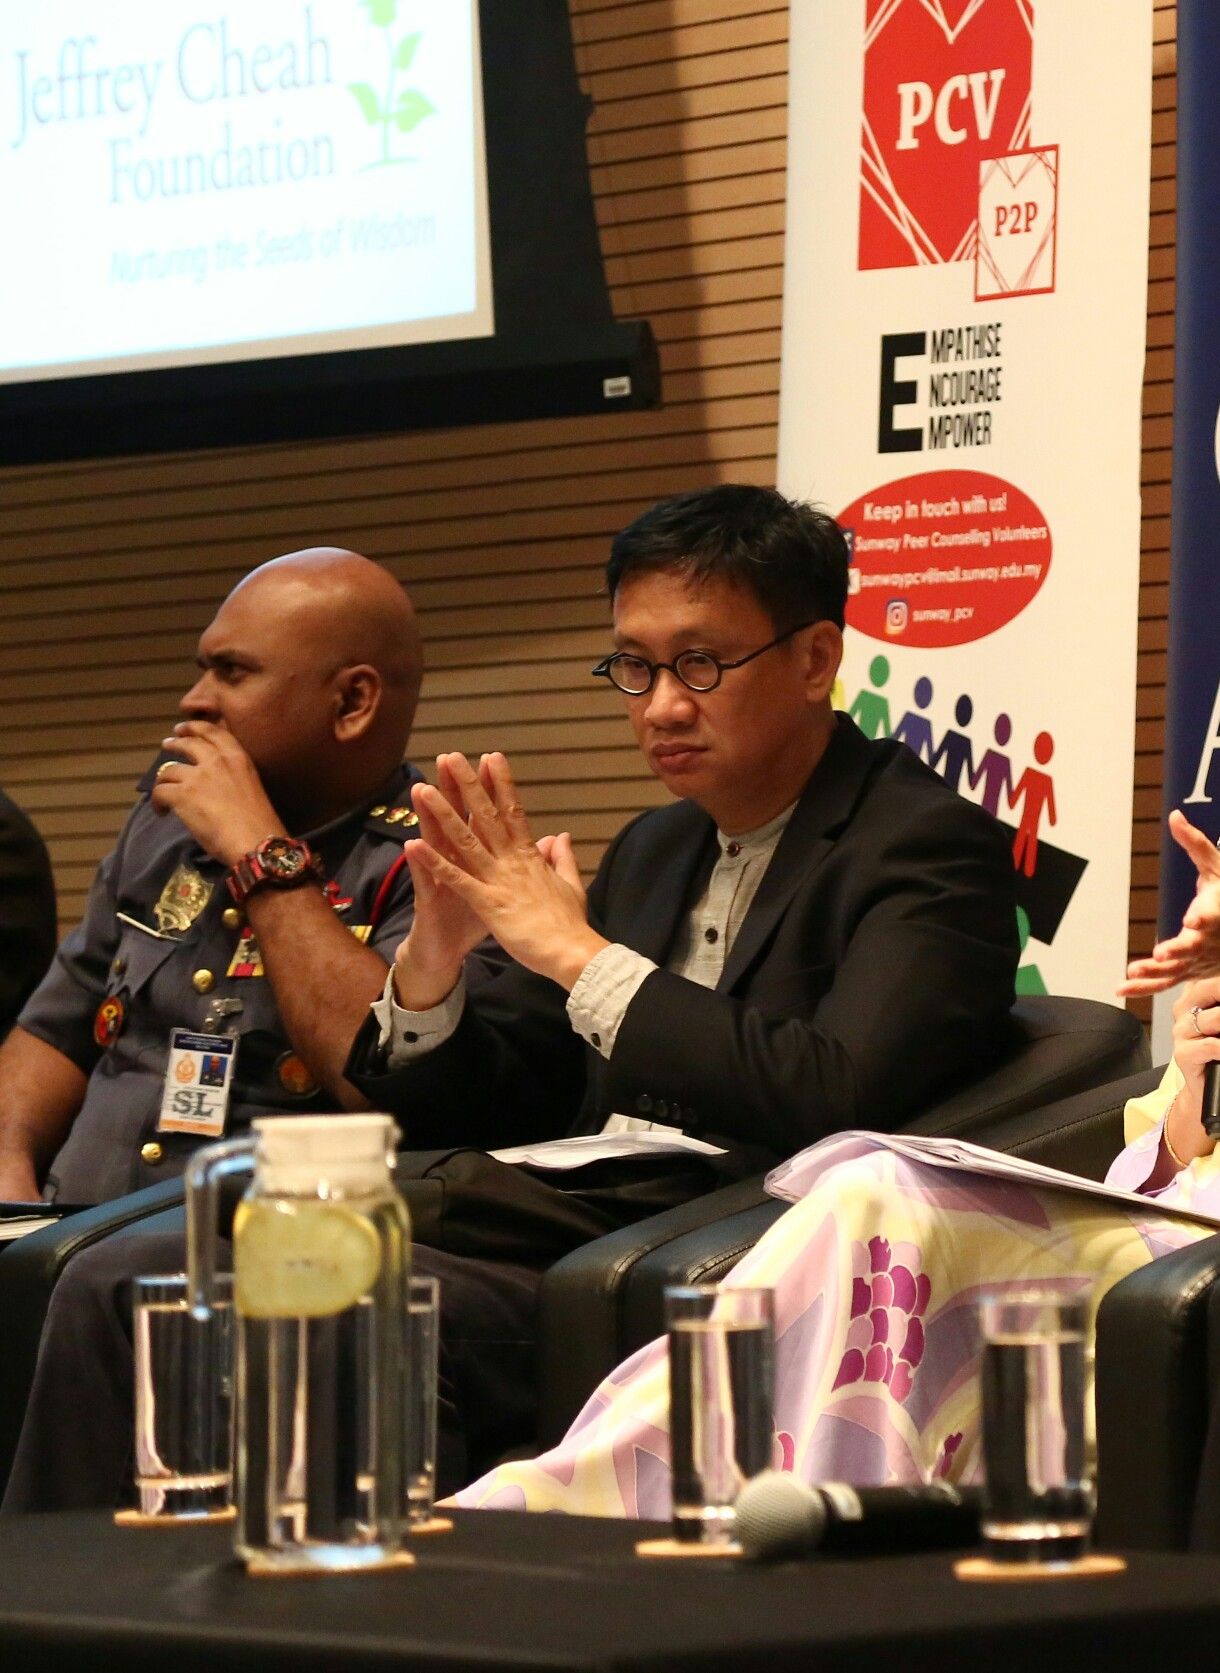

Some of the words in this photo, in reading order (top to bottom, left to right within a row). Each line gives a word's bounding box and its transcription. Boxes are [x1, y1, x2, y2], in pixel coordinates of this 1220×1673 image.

[9, 34, 165, 150] Jeffrey
[177, 3, 335, 105] Cheah
[895, 68, 1006, 151] PCV
[107, 117, 337, 204] Foundation
[994, 201, 1039, 237] P2P
[855, 536, 901, 553] Sunway
[902, 533, 930, 549] Peer
[991, 524, 1048, 542] Volunteers
[863, 502, 904, 524] Keep
[904, 499, 919, 519] in
[921, 497, 960, 518] touch
[961, 494, 988, 514] with
